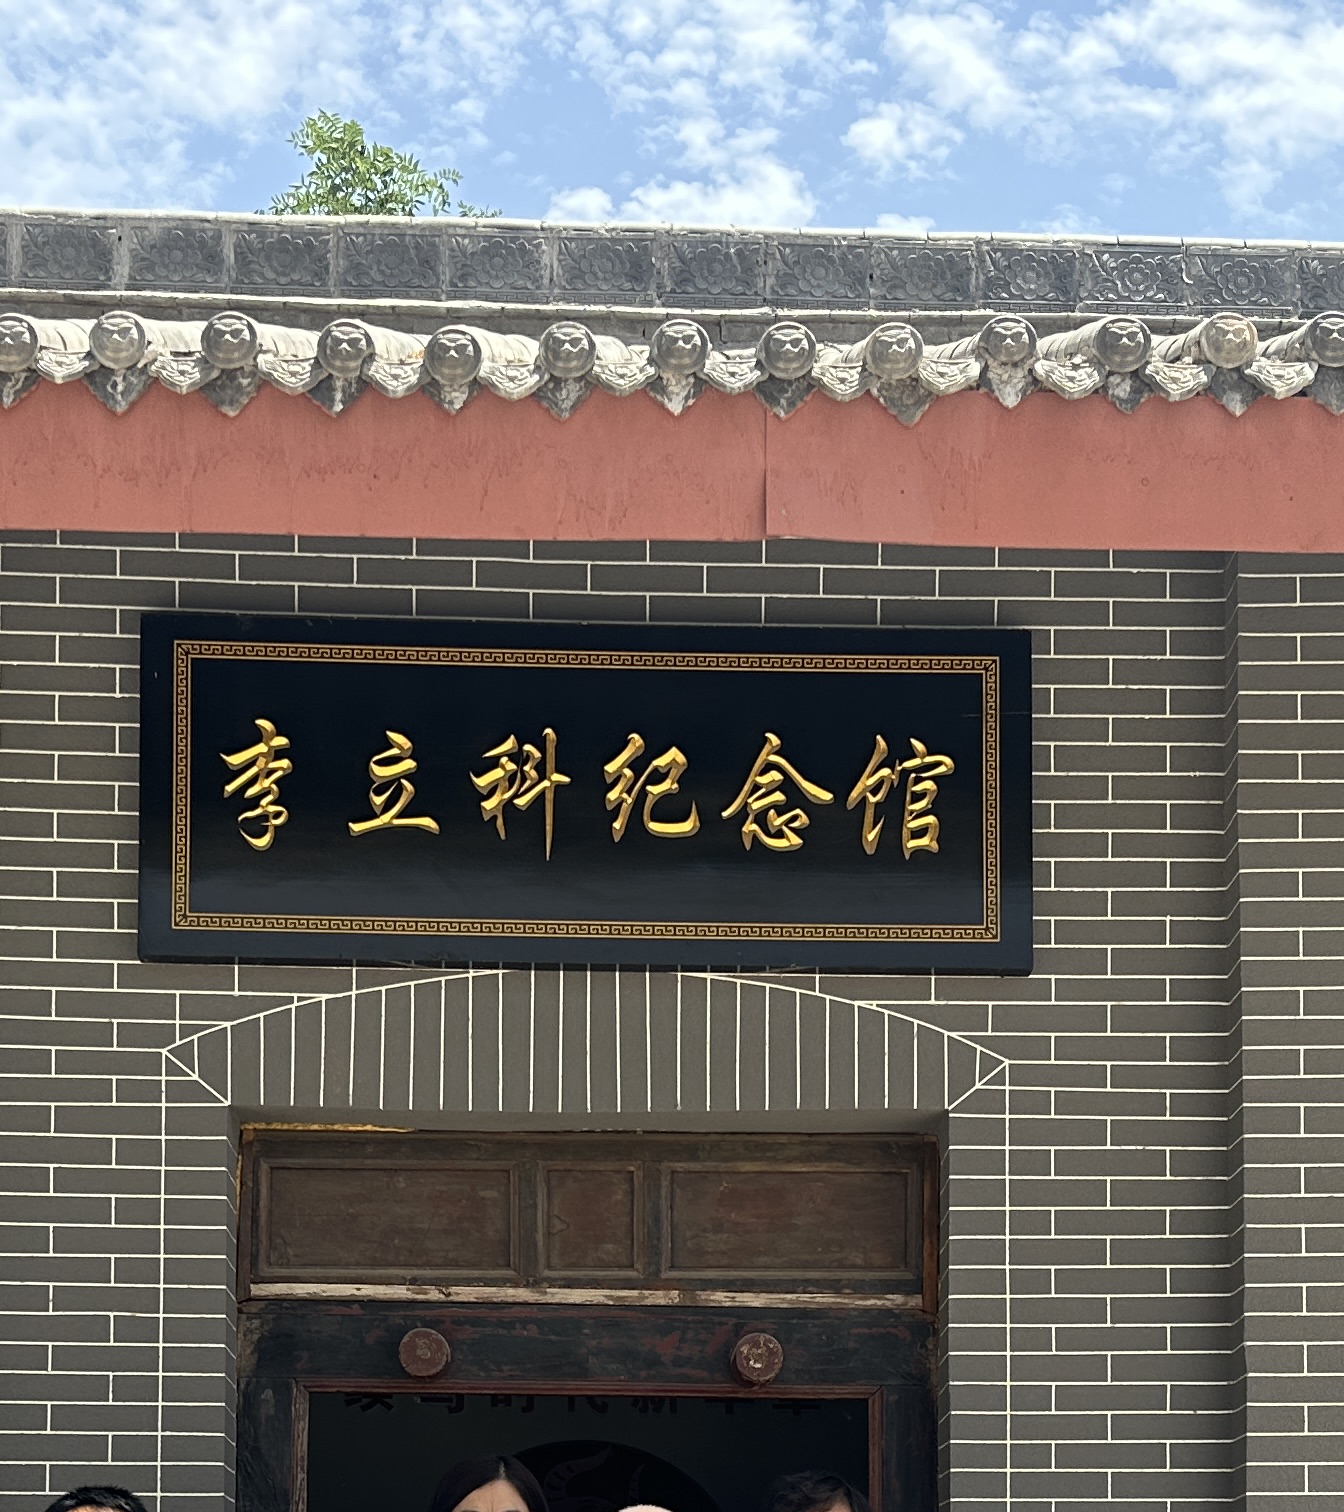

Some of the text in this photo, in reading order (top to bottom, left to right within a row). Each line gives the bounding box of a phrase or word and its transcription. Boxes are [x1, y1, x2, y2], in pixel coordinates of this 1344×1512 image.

[219, 718, 955, 862] 李立科纪念馆
